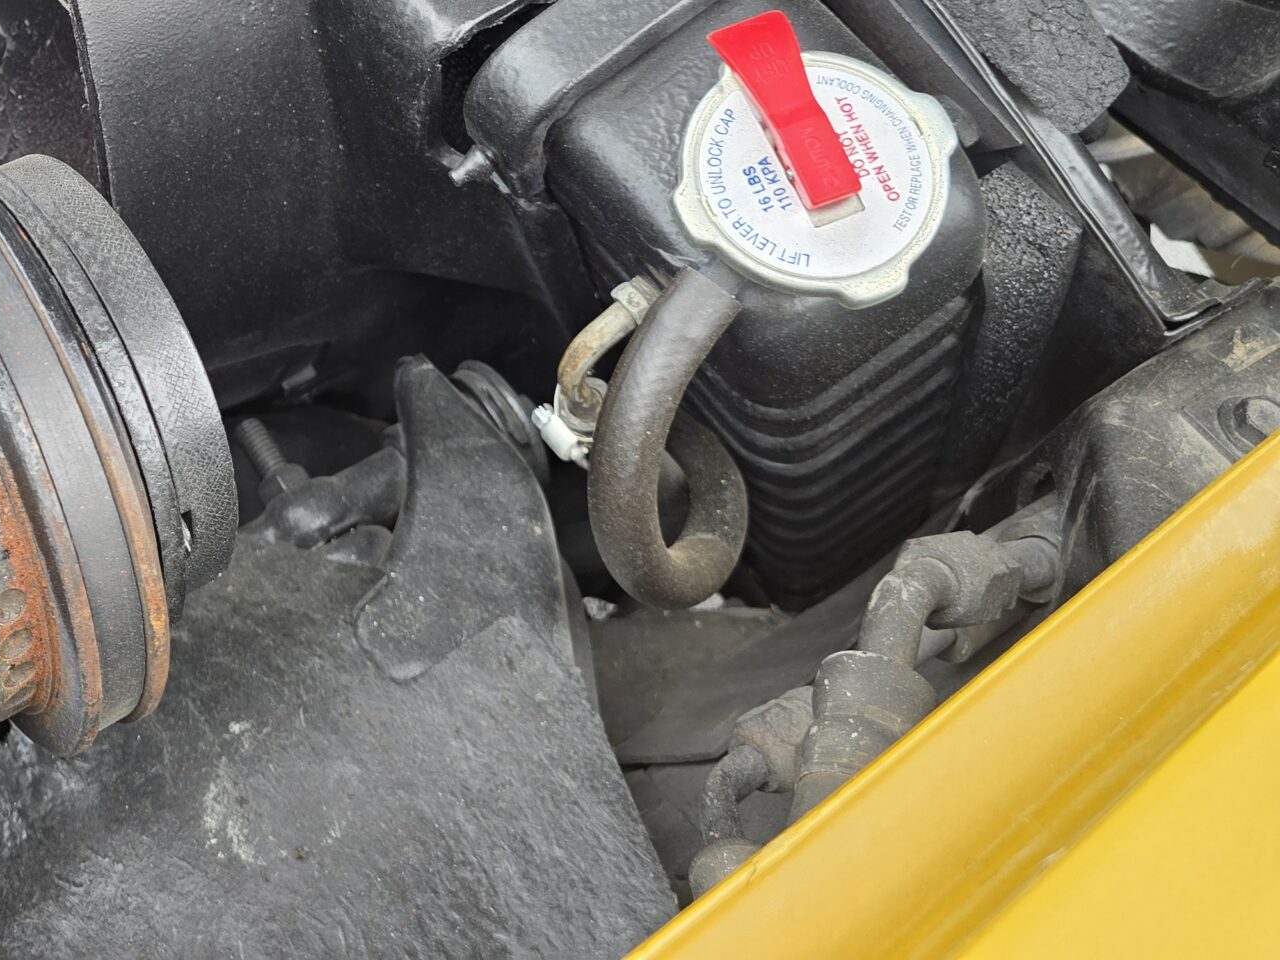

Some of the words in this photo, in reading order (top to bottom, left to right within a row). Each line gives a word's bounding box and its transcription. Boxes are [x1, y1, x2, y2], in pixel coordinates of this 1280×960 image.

[816, 75, 861, 94] COOLANT
[834, 97, 859, 122] HOT
[861, 90, 902, 126] CHANGING
[715, 108, 736, 135] CAP
[839, 131, 859, 157] NOT
[850, 124, 879, 163] WHEN
[897, 127, 917, 153] WHEN
[707, 137, 726, 195] UNLOCK
[758, 156, 781, 185] KPA
[853, 159, 870, 178] DO
[909, 154, 922, 195] REPLACE
[743, 166, 766, 194] LBS
[872, 165, 900, 202] OPEN
[717, 198, 736, 219] TO
[759, 196, 774, 213] 16
[773, 187, 792, 211] 110
[905, 196, 919, 210] OR
[892, 209, 912, 232] TEST
[732, 217, 778, 256] LEVER
[777, 248, 811, 267] LIFT
